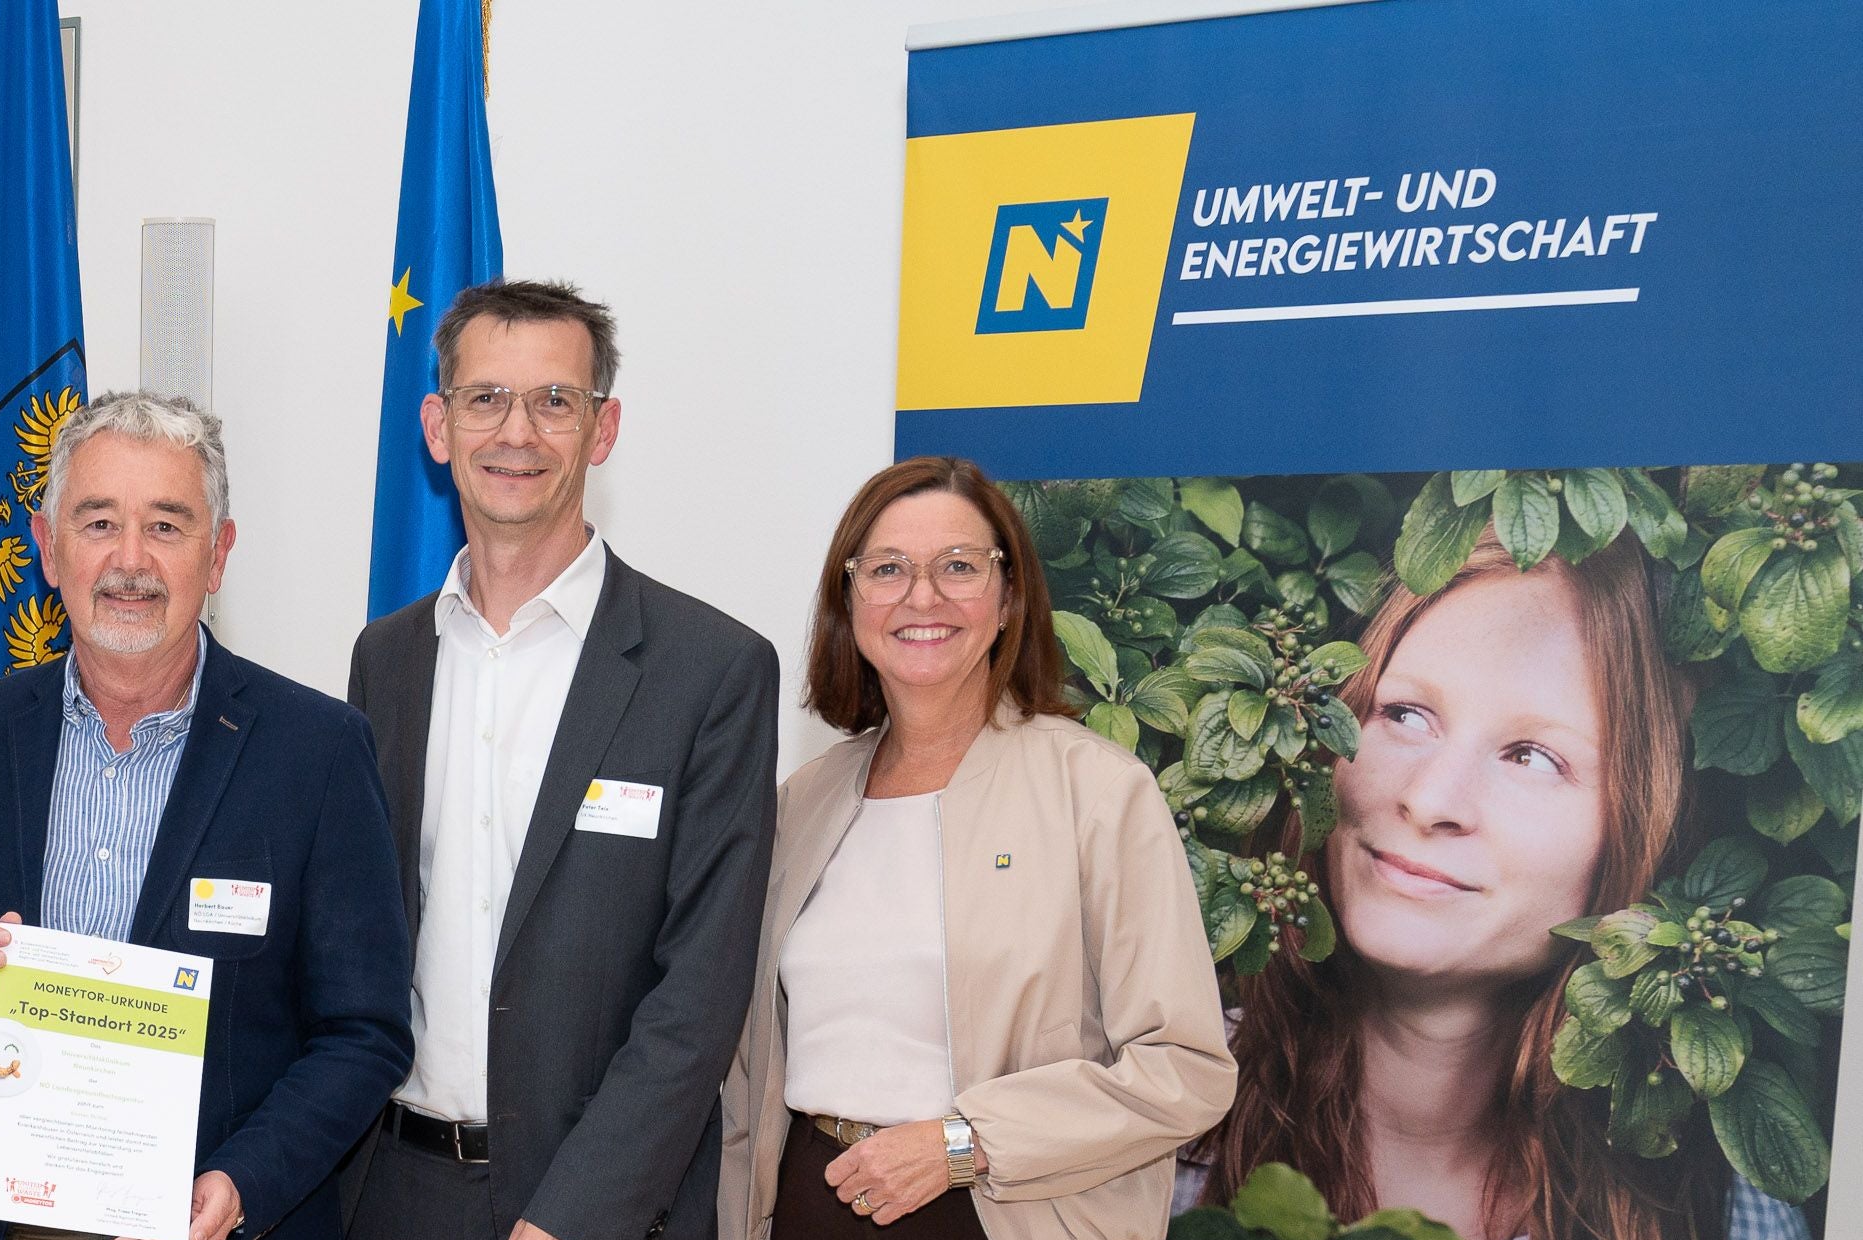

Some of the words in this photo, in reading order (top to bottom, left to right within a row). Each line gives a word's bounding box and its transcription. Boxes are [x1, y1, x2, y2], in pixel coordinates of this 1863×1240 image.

[1192, 177, 1384, 228] UMWELT-
[1395, 167, 1497, 213] UND
[1180, 211, 1658, 282] ENERGIEWIRTSCHAFT
[33, 981, 169, 1014] MONEYTOR-URKUNDE
